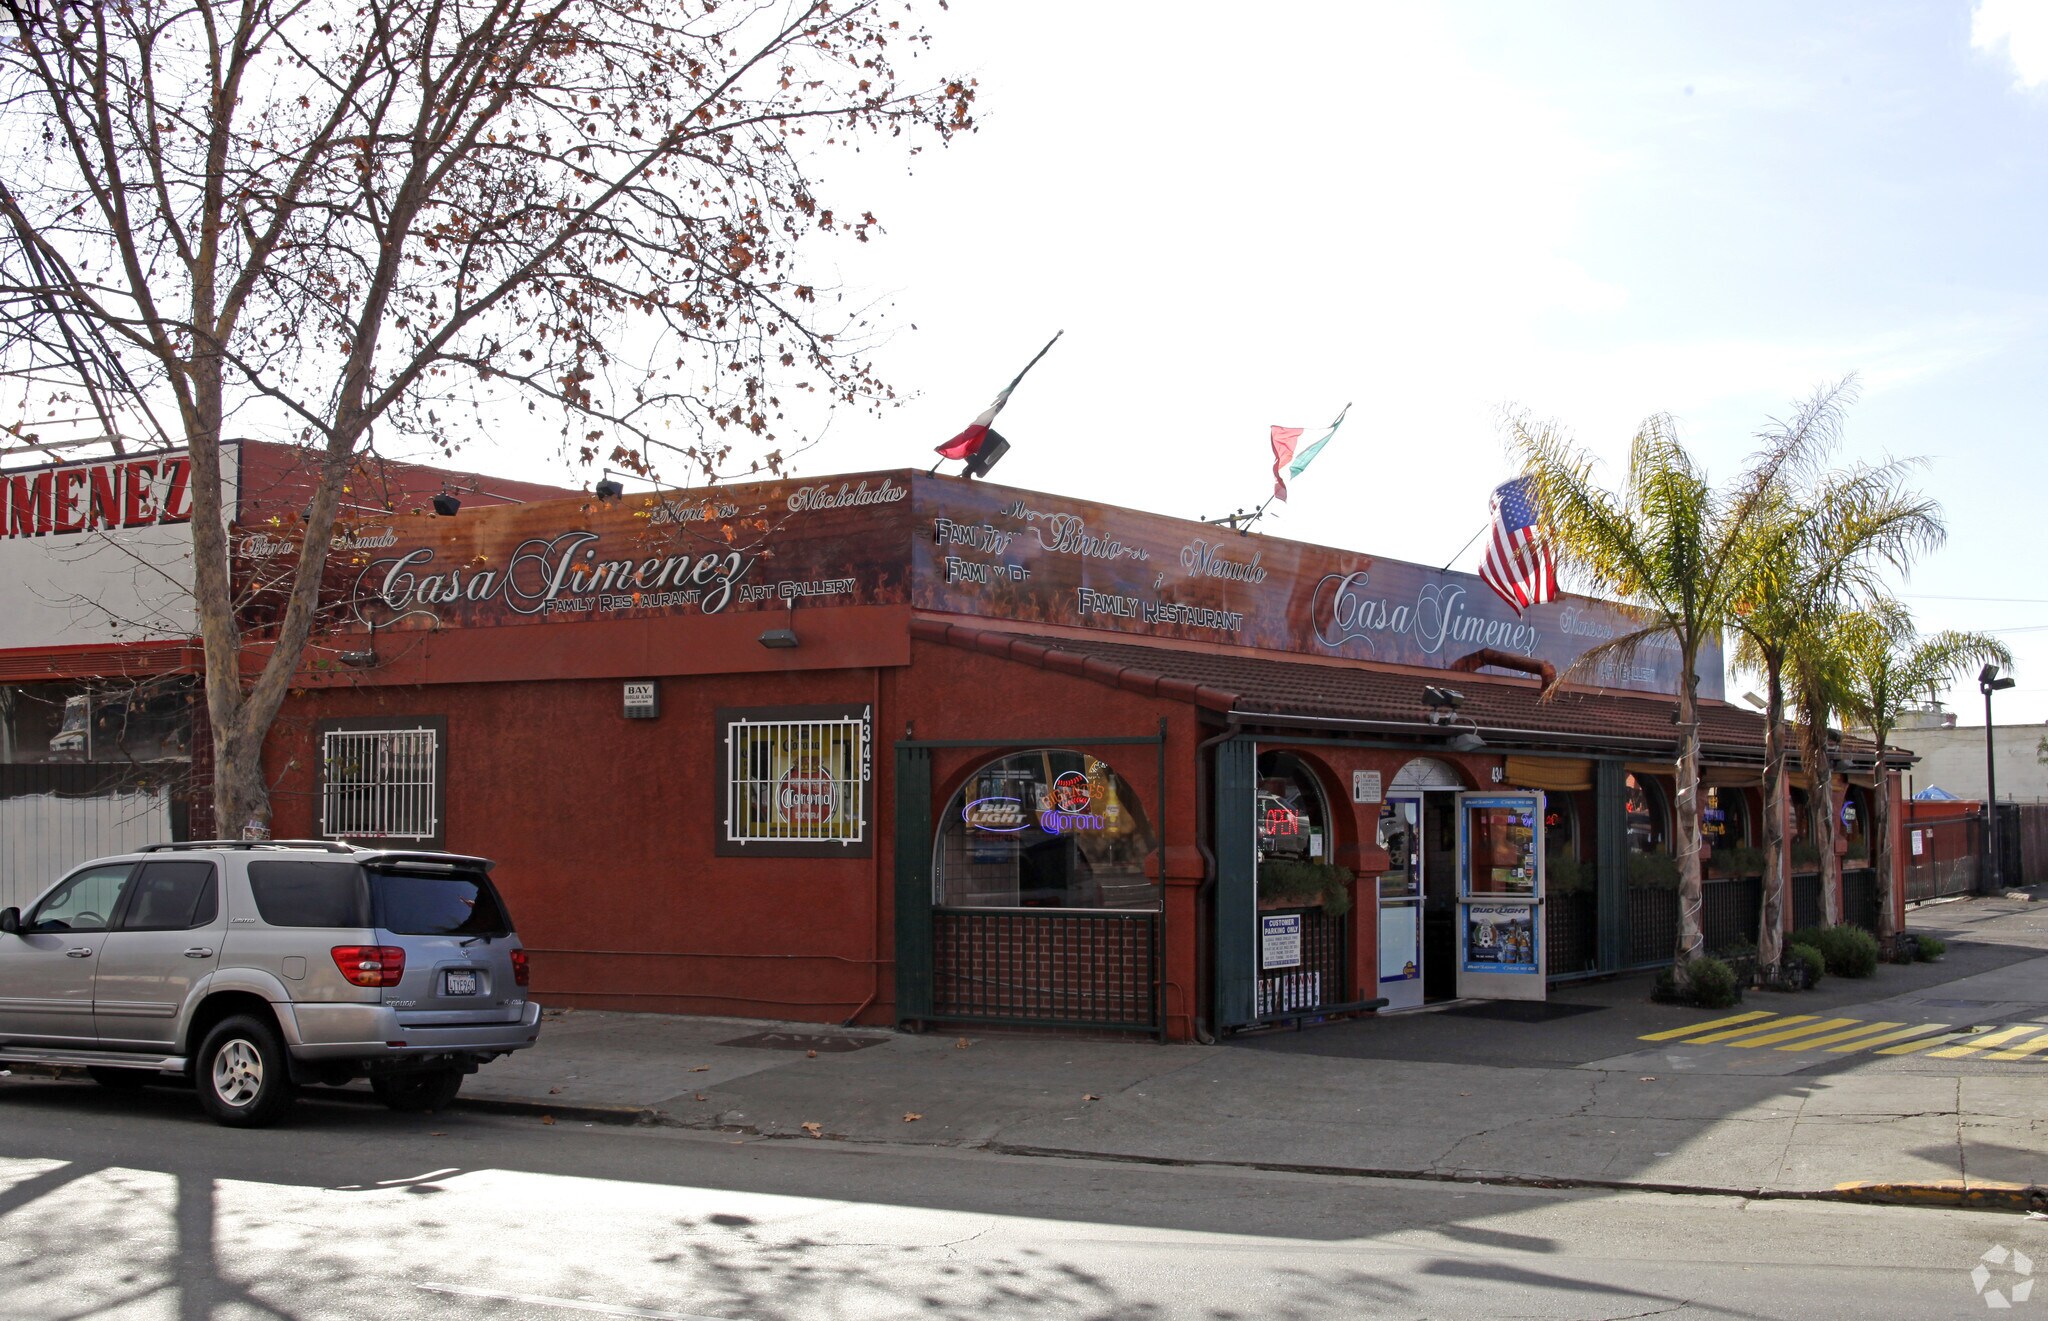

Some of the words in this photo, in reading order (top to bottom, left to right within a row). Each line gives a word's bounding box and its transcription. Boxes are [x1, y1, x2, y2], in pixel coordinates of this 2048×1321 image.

[787, 478, 907, 512] Micheladas
[1180, 538, 1267, 584] Menudo
[353, 549, 504, 629] Casa
[504, 532, 755, 614] Jimenez
[739, 584, 775, 603] ART
[778, 578, 856, 600] GALLERY
[543, 597, 595, 616] FAMILY
[599, 590, 701, 613] RESAURANT
[1078, 588, 1138, 617] FAMILY
[1142, 600, 1243, 631] RESTAURANT
[1312, 571, 1411, 654] Casa
[1414, 583, 1541, 659] Jimenez
[628, 686, 649, 694] BAY
[862, 704, 871, 782] 4345
[971, 813, 1027, 823] LIGHT
[978, 803, 1020, 813] BUD
[1041, 810, 1104, 834] Corona
[1266, 809, 1298, 835] OPEN
[1499, 907, 1528, 915] LIGHT
[1265, 927, 1285, 935] PARKING
